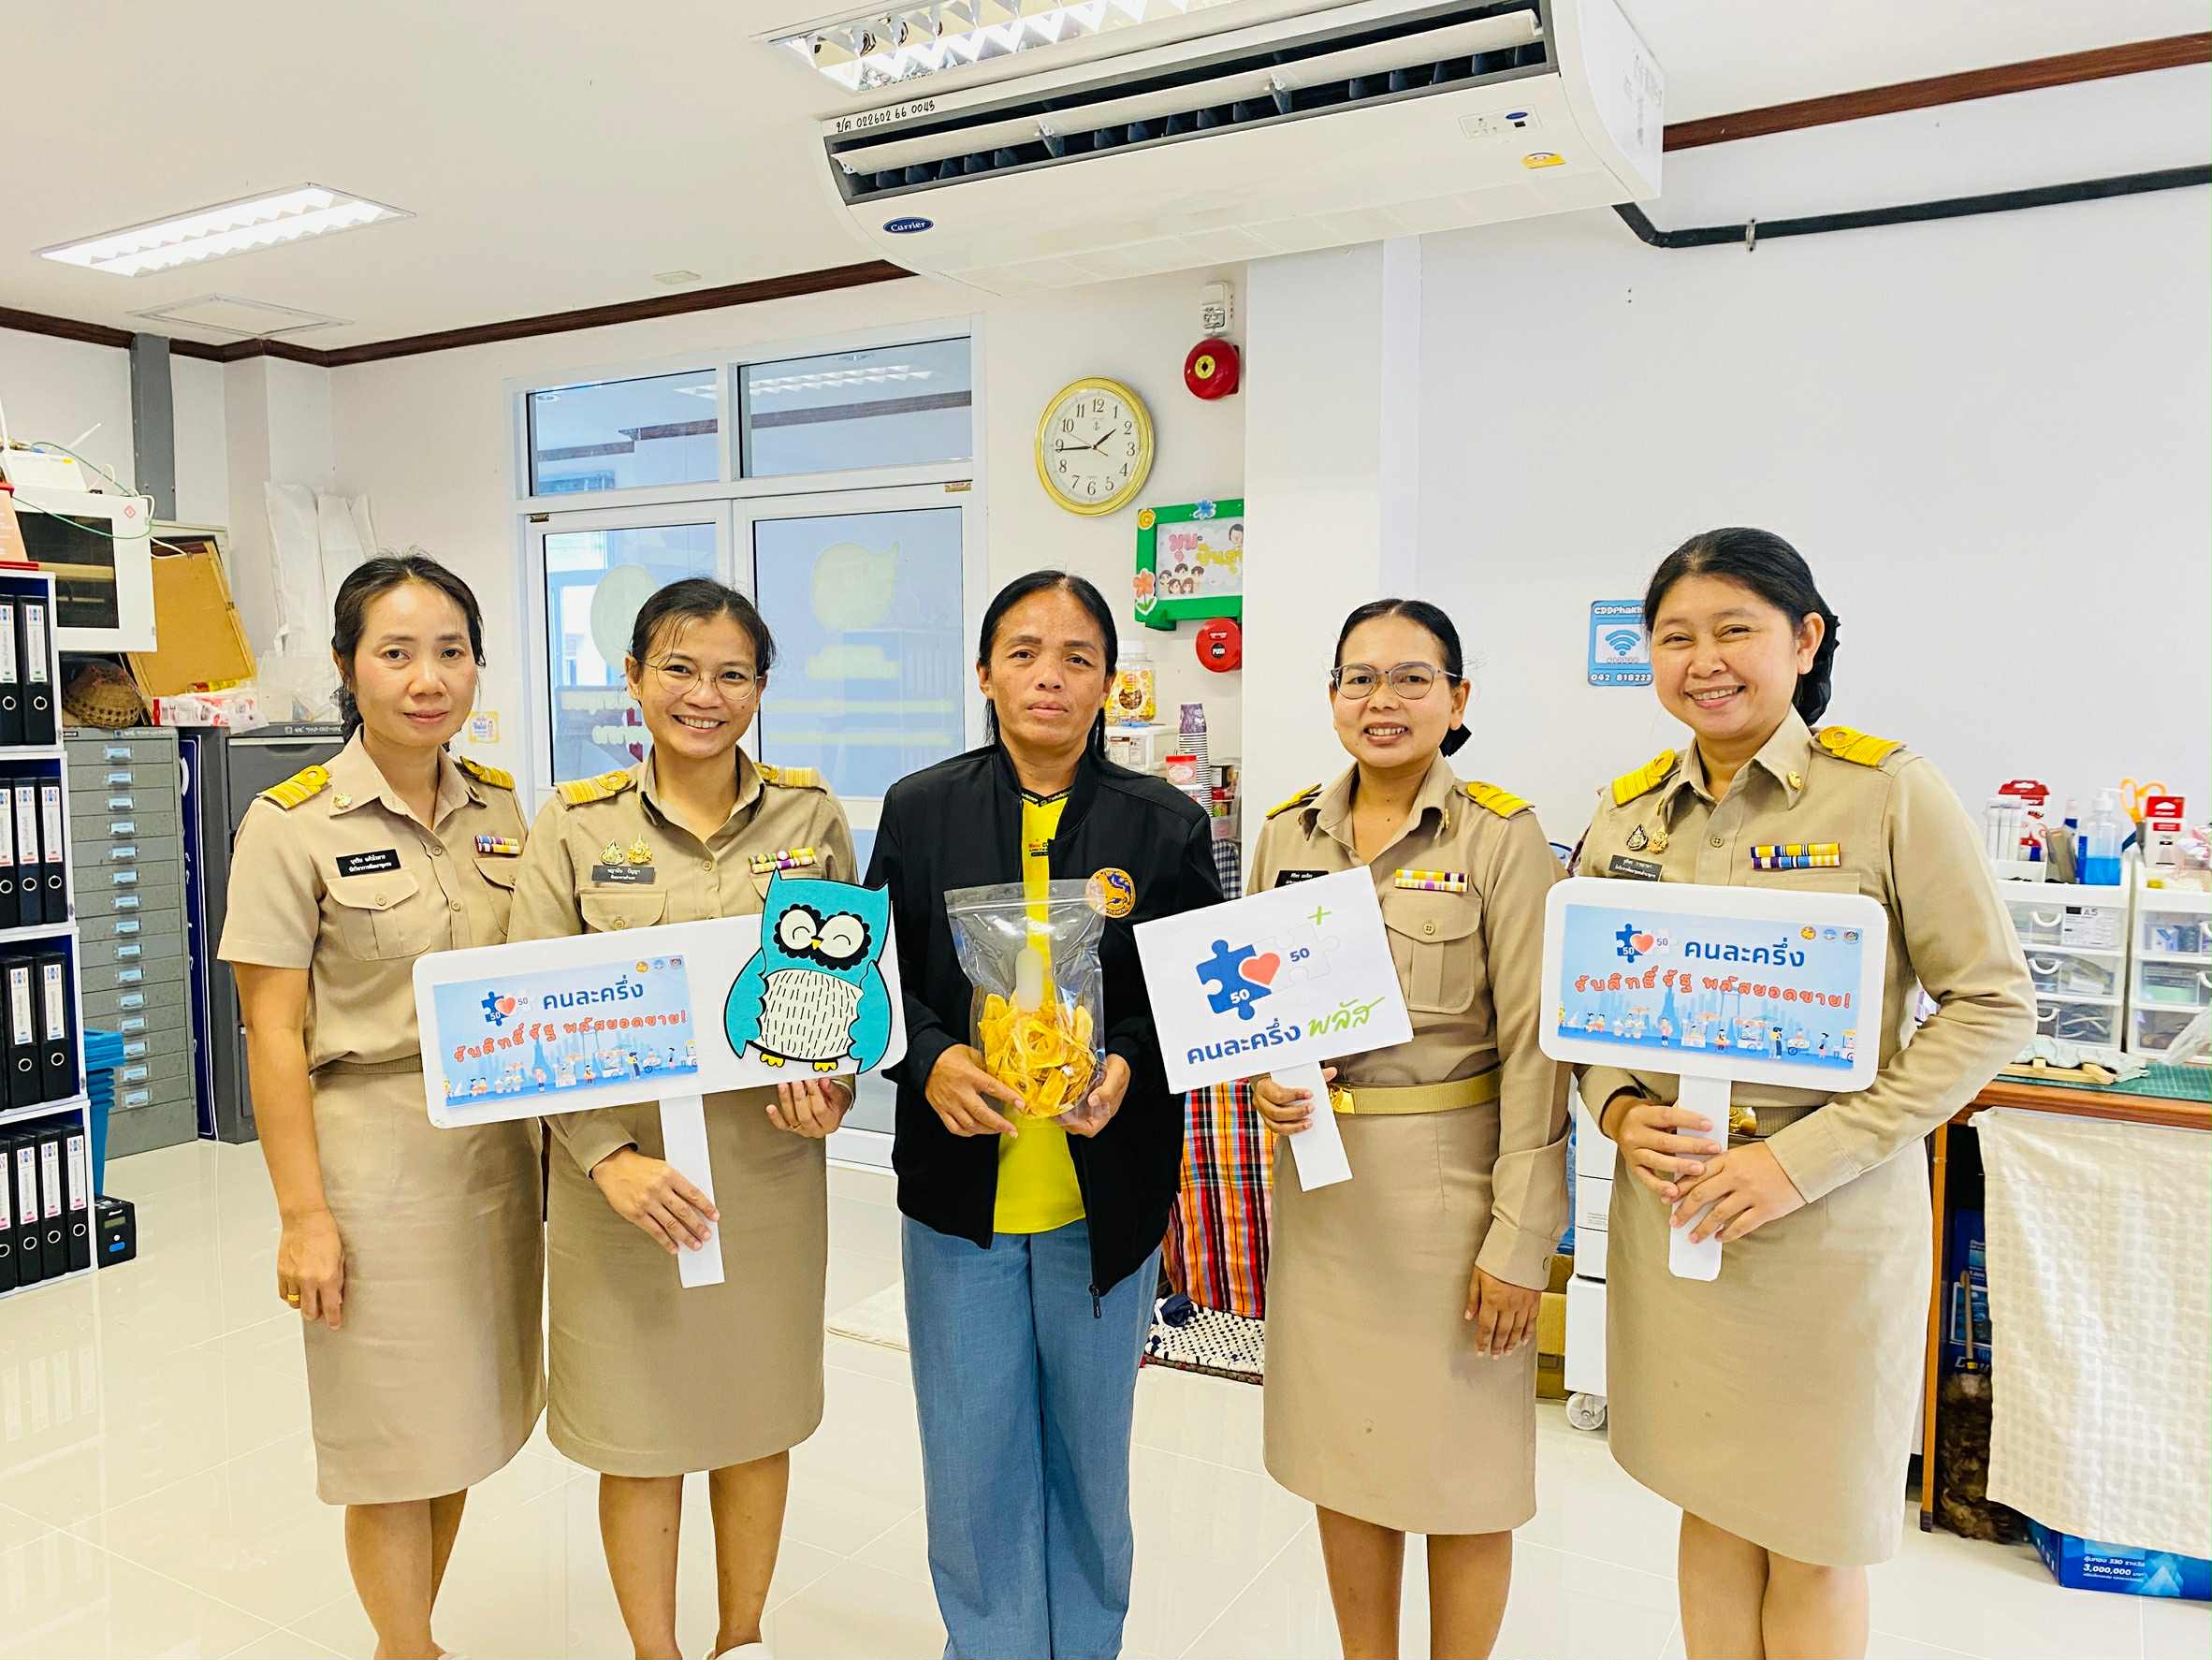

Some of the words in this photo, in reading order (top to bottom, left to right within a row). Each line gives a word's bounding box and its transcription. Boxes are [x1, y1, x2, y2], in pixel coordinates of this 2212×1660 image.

[856, 110, 892, 128] 022602
[895, 108, 907, 119] 66
[890, 221, 926, 232] Carrier
[1076, 403, 1085, 418] 11
[1093, 398, 1105, 413] 12
[1113, 405, 1118, 419] 1
[1062, 418, 1074, 432] 10
[1124, 420, 1132, 435] 2
[1055, 438, 1064, 454] 9
[1127, 442, 1135, 457] 3
[1058, 459, 1068, 473] 8
[1119, 462, 1128, 477] 4
[1071, 474, 1081, 488] 7
[1105, 476, 1114, 491] 5
[1087, 482, 1096, 496] 6
[1594, 605, 1646, 615] CDDPhaKh
[1591, 673, 1610, 681] 042
[1656, 938, 1668, 946] 50
[1289, 947, 1311, 963] 50
[1623, 946, 1635, 955] 50
[1683, 937, 1806, 968] คนละครึ่ง
[542, 974, 646, 1011] คนละครึ่ง
[1230, 988, 1251, 1005] 50
[517, 997, 529, 1006] 50
[489, 1012, 502, 1021] 50
[1186, 1018, 1302, 1065] คนละครึ่ง
[1307, 996, 1386, 1038] พลัส
[2083, 1564, 2132, 1576] 3,000,000
